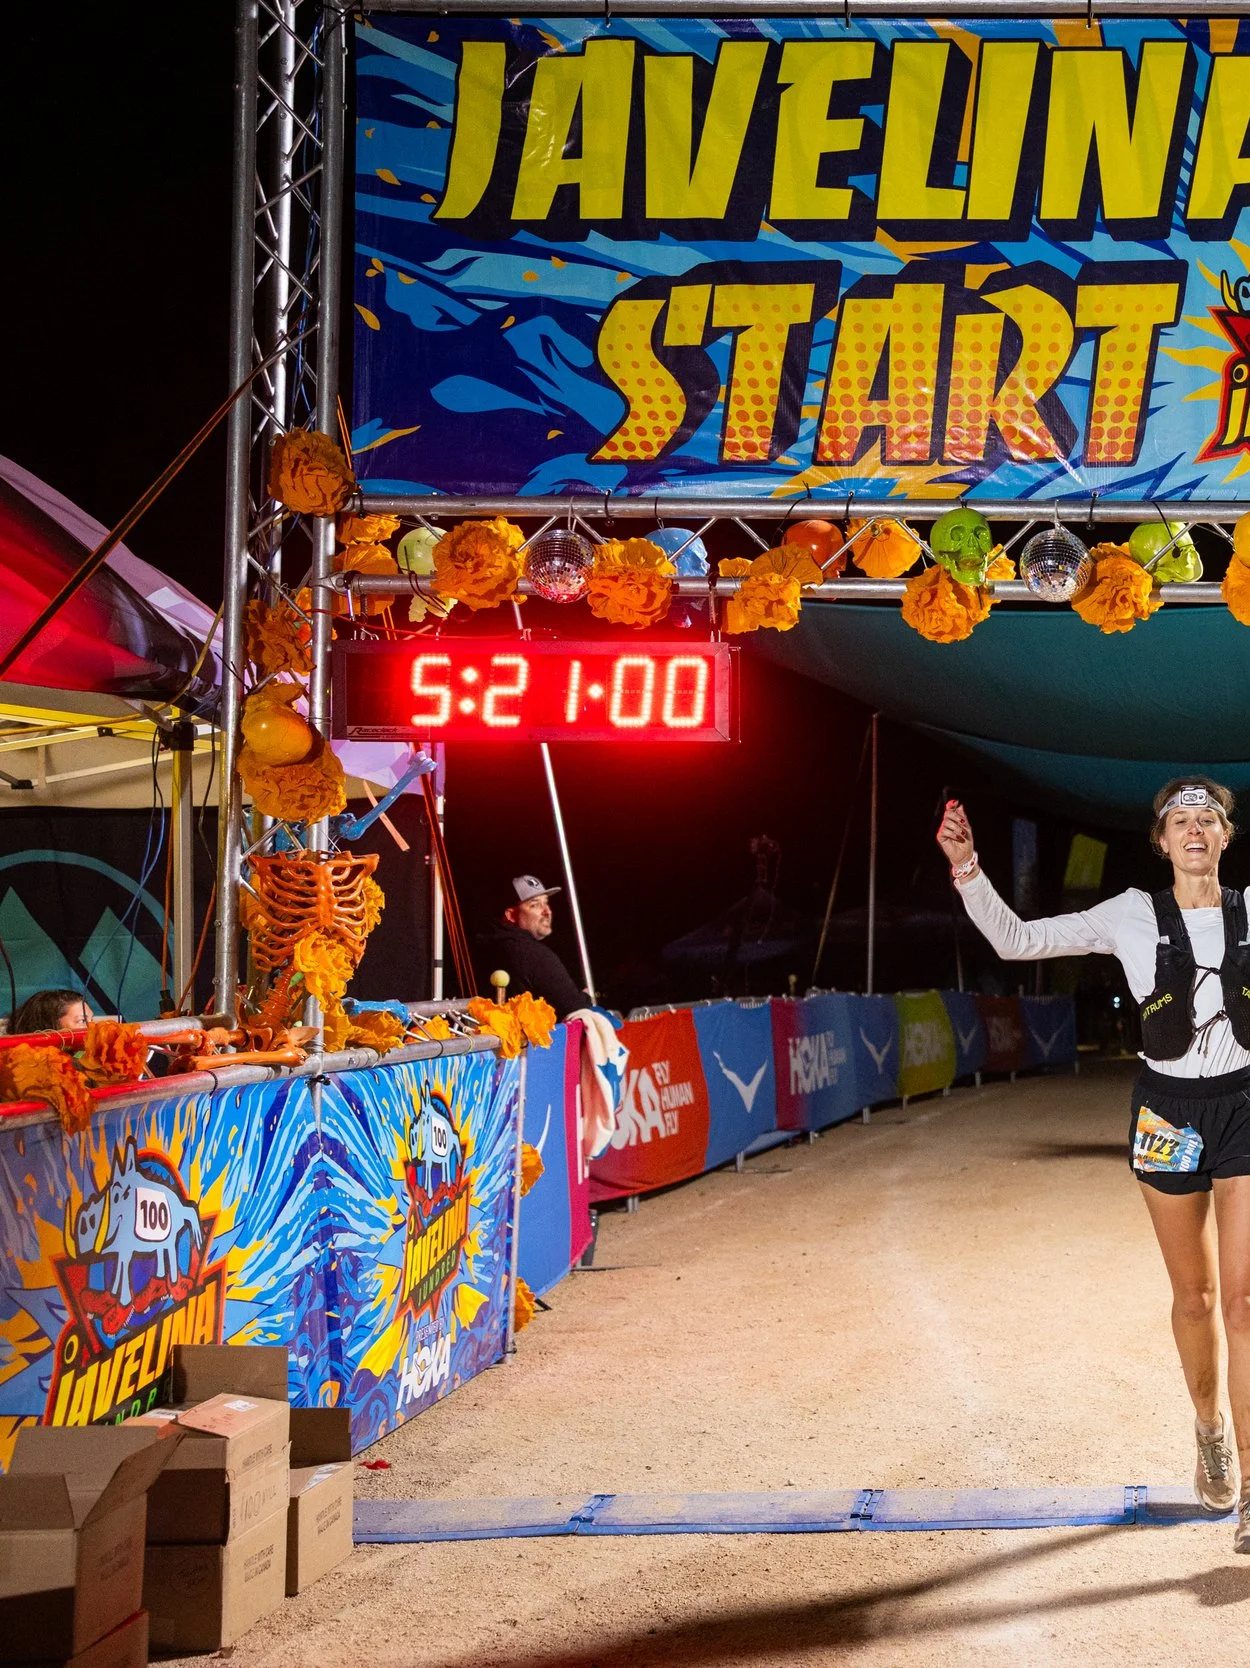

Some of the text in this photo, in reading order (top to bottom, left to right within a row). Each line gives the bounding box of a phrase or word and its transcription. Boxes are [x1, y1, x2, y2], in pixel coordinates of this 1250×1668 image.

[591, 282, 1180, 463] START
[652, 1060, 670, 1086] FLY
[787, 1033, 831, 1096] HOKA
[660, 1081, 694, 1111] HUMAN
[433, 1125, 447, 1148] 100
[662, 1111, 679, 1138] FLY
[1140, 1131, 1180, 1156] 1123
[141, 1199, 168, 1231] 100
[403, 1189, 468, 1304] JAVELINA
[418, 1250, 457, 1307] JUNDRED
[396, 1333, 452, 1411] HOKA
